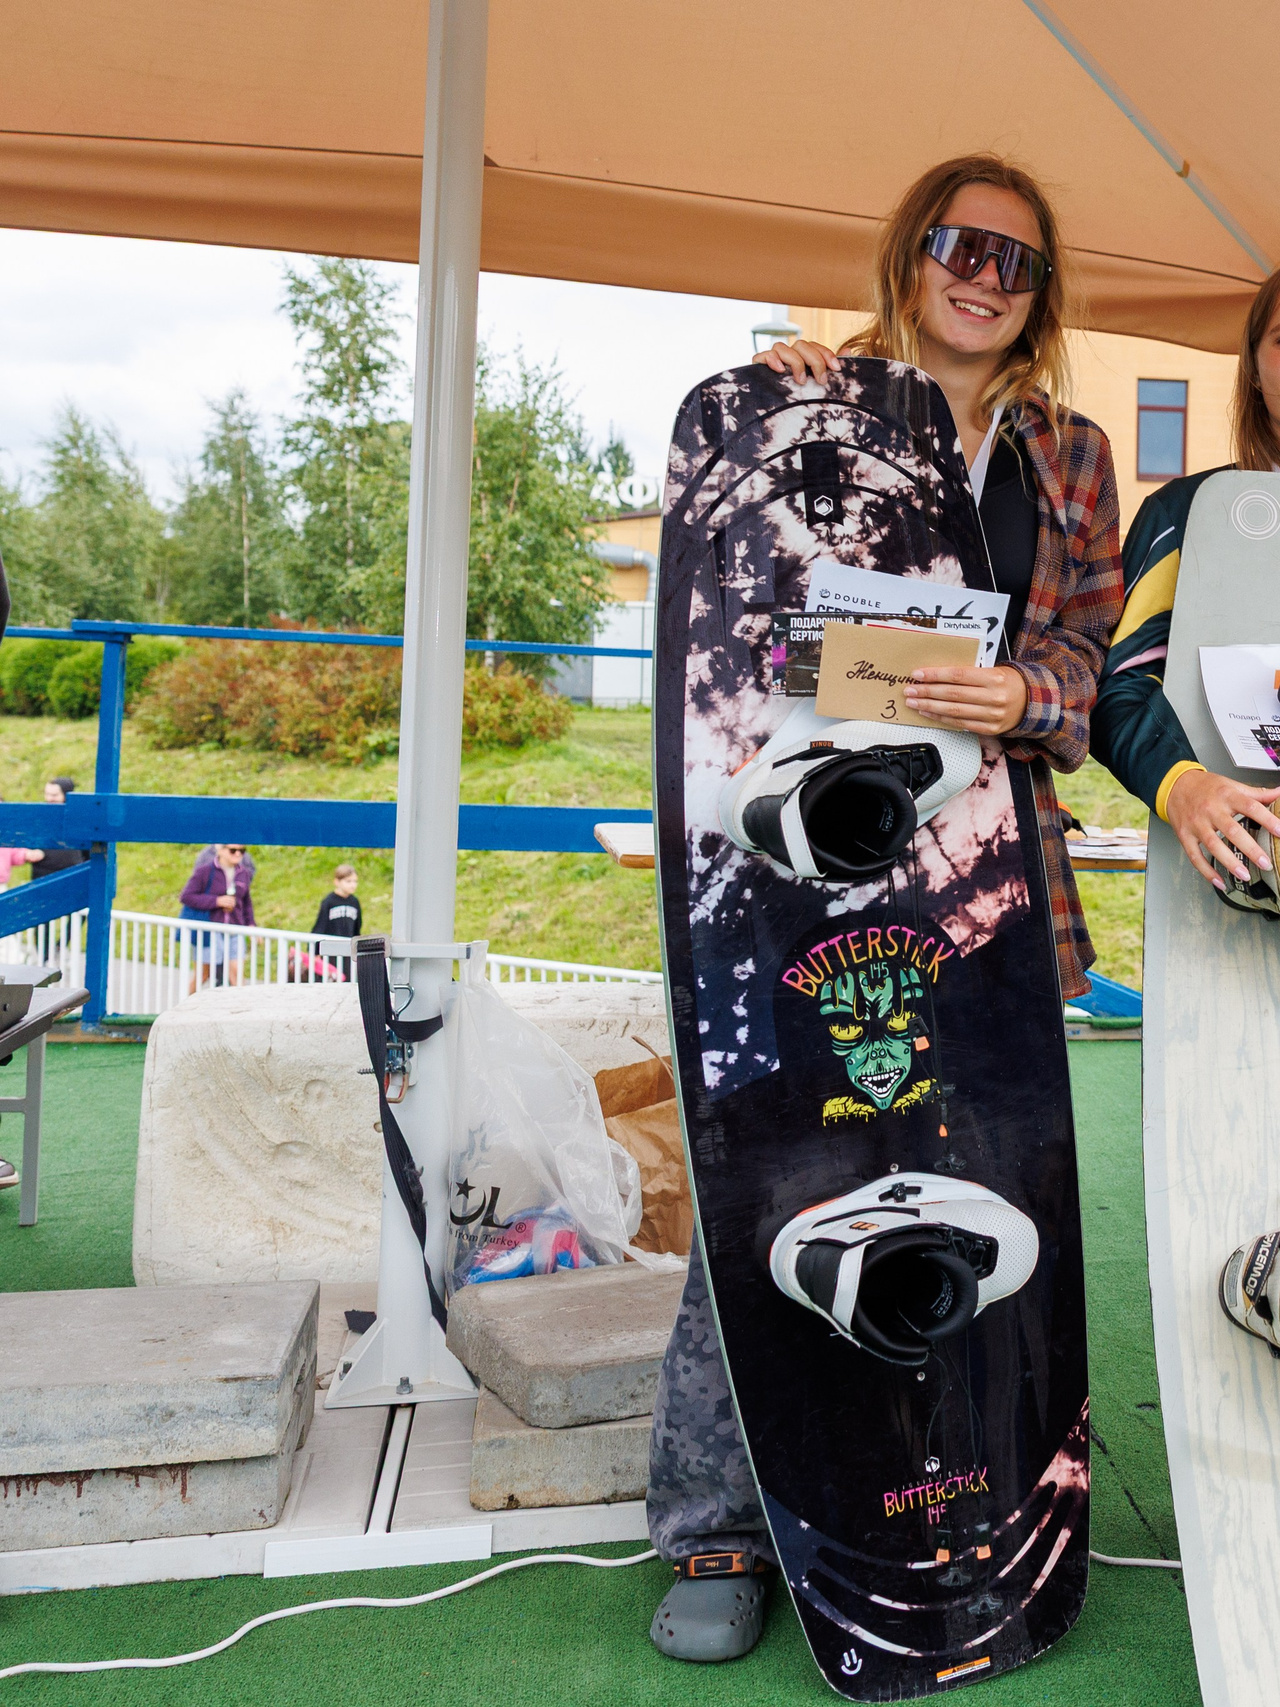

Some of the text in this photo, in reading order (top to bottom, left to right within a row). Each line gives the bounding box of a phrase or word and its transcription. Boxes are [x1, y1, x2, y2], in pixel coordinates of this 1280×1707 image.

[834, 593, 881, 609] DOUBLE
[790, 630, 824, 641] СЕРТИФ
[880, 699, 899, 720] 3.
[1228, 712, 1261, 721] Подаро
[782, 925, 955, 997] BUTTERSTICK
[869, 961, 890, 979] 145
[455, 1229, 478, 1241] from
[483, 1233, 521, 1249] Turkey.
[1245, 1233, 1276, 1297] PACEMOB
[883, 1466, 989, 1518] BUTTERSTICK
